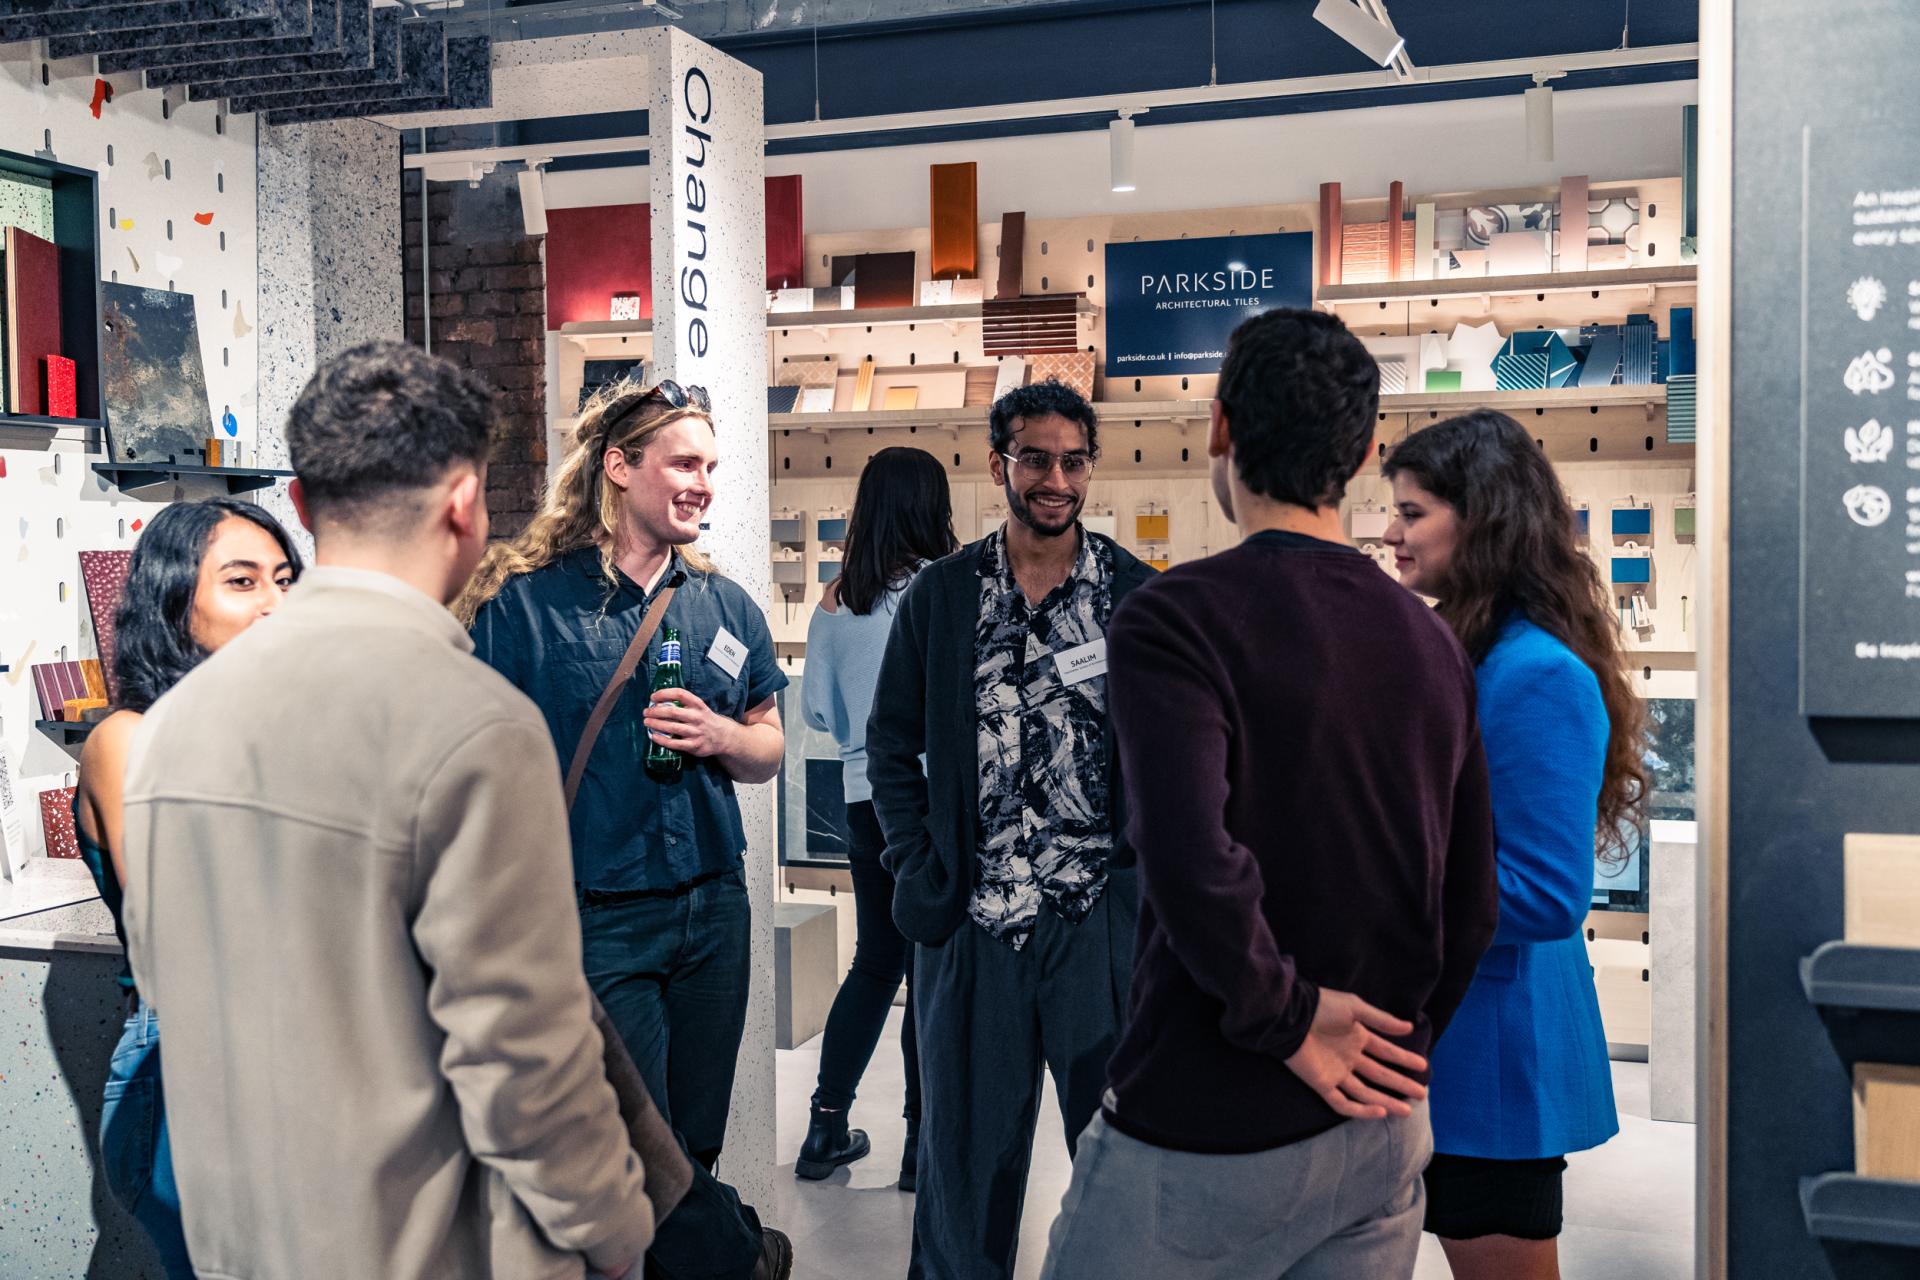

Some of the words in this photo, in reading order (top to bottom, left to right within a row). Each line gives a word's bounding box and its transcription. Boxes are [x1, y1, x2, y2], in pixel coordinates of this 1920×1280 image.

[681, 67, 711, 358] Change
[1141, 268, 1274, 295] PARKSIDE
[1155, 299, 1231, 310] ARCHITECTURAL
[1234, 297, 1260, 306] TILES
[1117, 353, 1166, 363] parkside.co.uk
[724, 644, 736, 657] EDEN
[1070, 653, 1097, 668] SAALIM
